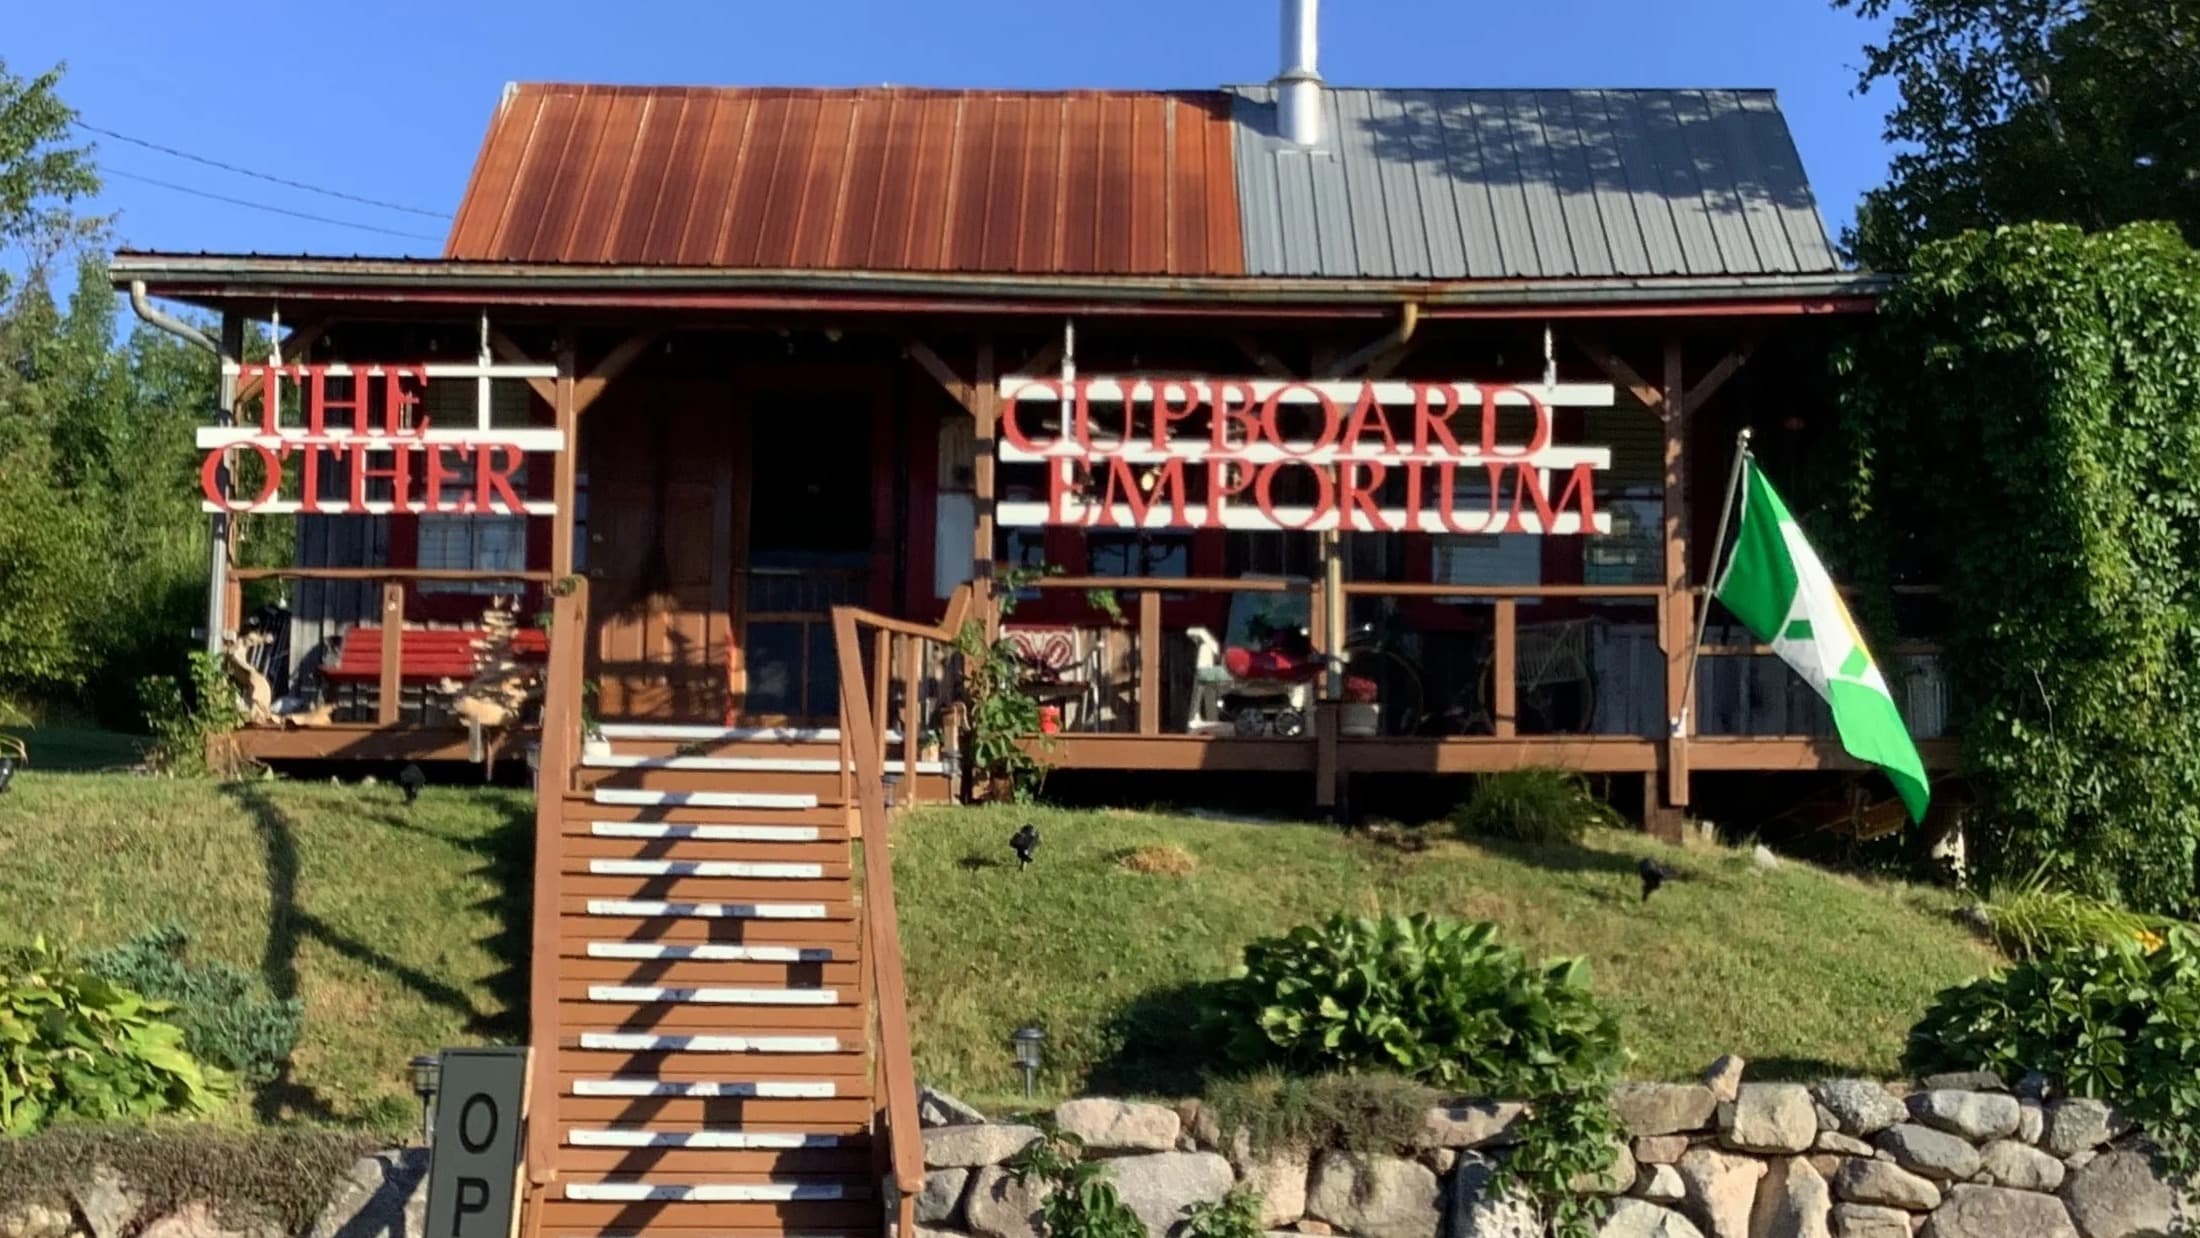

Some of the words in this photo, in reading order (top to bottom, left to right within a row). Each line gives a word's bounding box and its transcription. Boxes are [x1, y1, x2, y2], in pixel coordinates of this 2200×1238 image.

[238, 364, 430, 439] THE
[1002, 379, 1550, 455] CUPBOARD
[201, 440, 530, 513] OTHER
[1048, 455, 1597, 534] EMPORIUM
